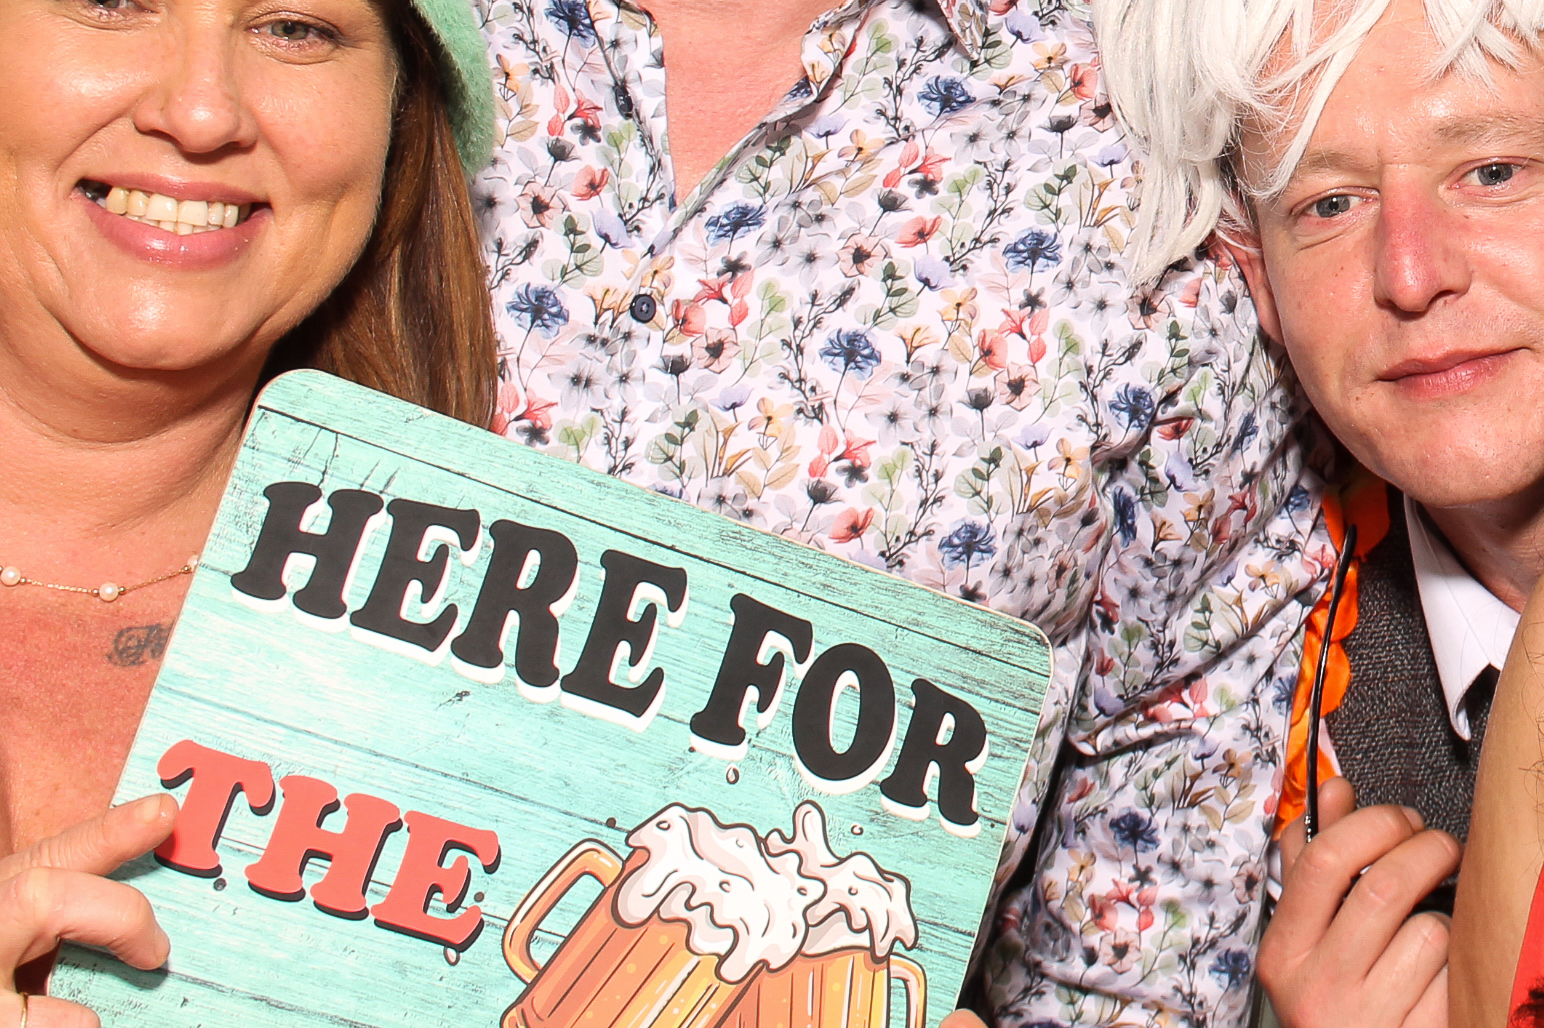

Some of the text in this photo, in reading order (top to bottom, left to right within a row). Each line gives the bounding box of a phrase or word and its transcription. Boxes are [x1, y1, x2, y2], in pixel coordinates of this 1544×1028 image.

[230, 481, 990, 835] HERE FOR
[155, 739, 501, 952] THE
